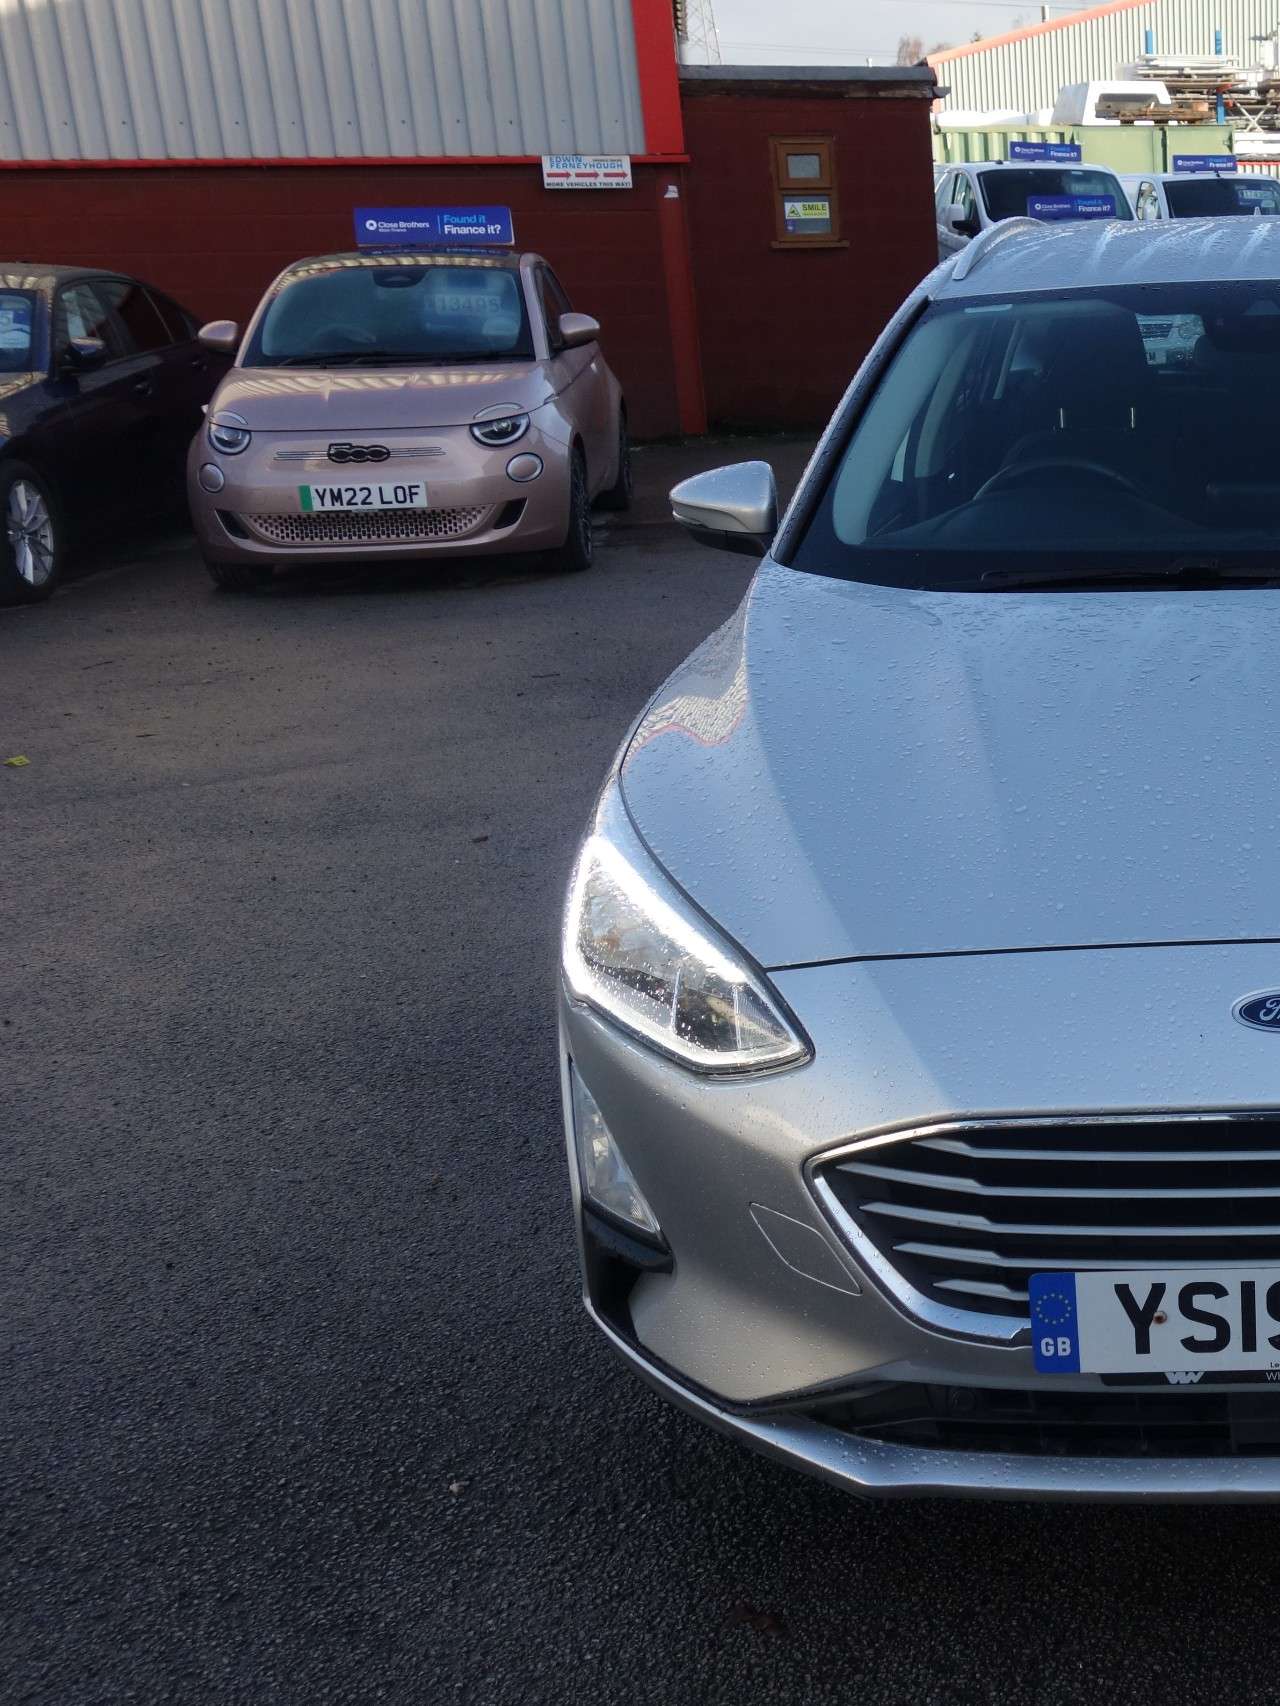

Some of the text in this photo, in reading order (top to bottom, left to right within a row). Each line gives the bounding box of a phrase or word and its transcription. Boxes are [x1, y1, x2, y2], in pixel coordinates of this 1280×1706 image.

[444, 214, 486, 224] Found it
[444, 225, 502, 234] Finance it?
[327, 443, 391, 464] 500
[315, 485, 421, 507] YM22 LOF
[1041, 1337, 1071, 1357] GB
